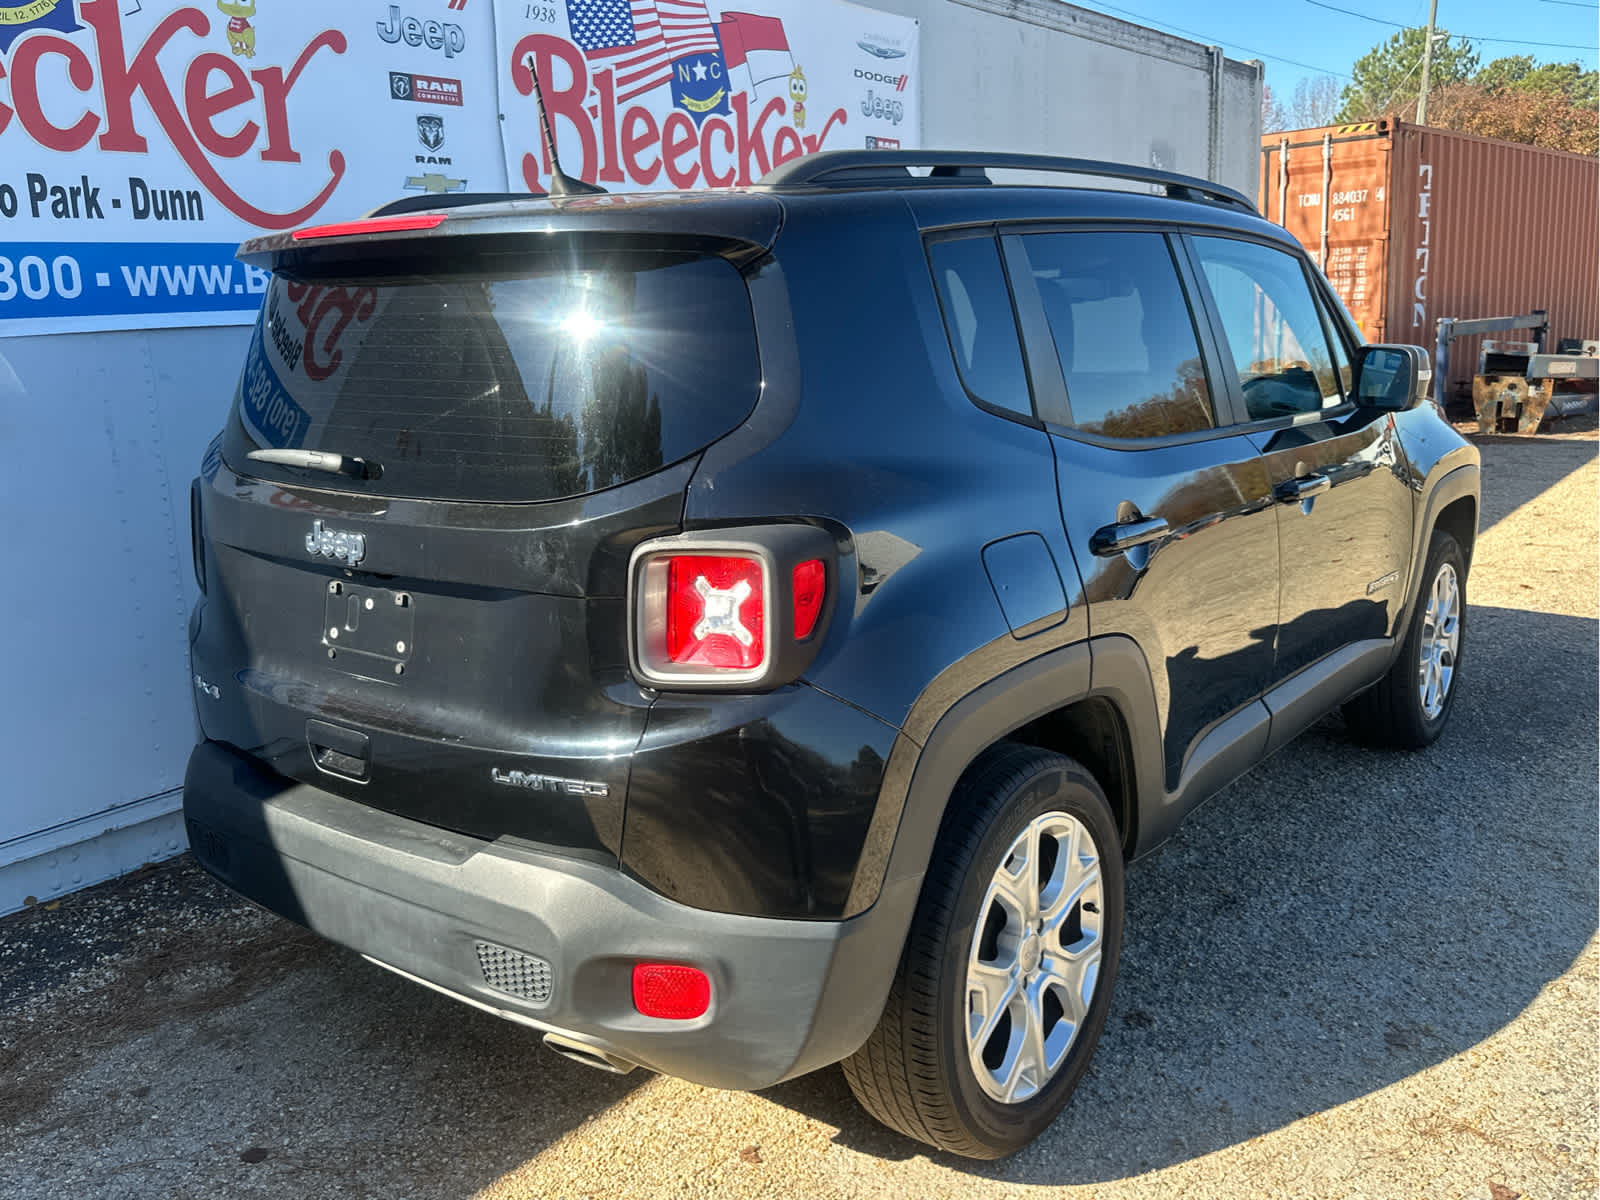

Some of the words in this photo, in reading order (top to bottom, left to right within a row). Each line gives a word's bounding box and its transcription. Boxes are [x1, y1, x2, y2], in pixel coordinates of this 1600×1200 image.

[29, 0, 51, 16] 1776
[526, 4, 556, 24] 1938
[376, 5, 465, 59] Jeep
[678, 63, 691, 82] N
[710, 62, 721, 79] C
[854, 69, 901, 86] DODGE
[416, 80, 458, 93] RAM
[417, 93, 459, 102] COMMERCIAL
[861, 89, 903, 126] Jeep
[511, 33, 848, 193] Bleecker
[415, 155, 452, 166] RAM
[26, 173, 104, 219] Park
[129, 177, 204, 221] Dunn
[1332, 190, 1368, 205] 884037
[305, 519, 365, 567] Jeep
[491, 767, 610, 797] LIMITED
